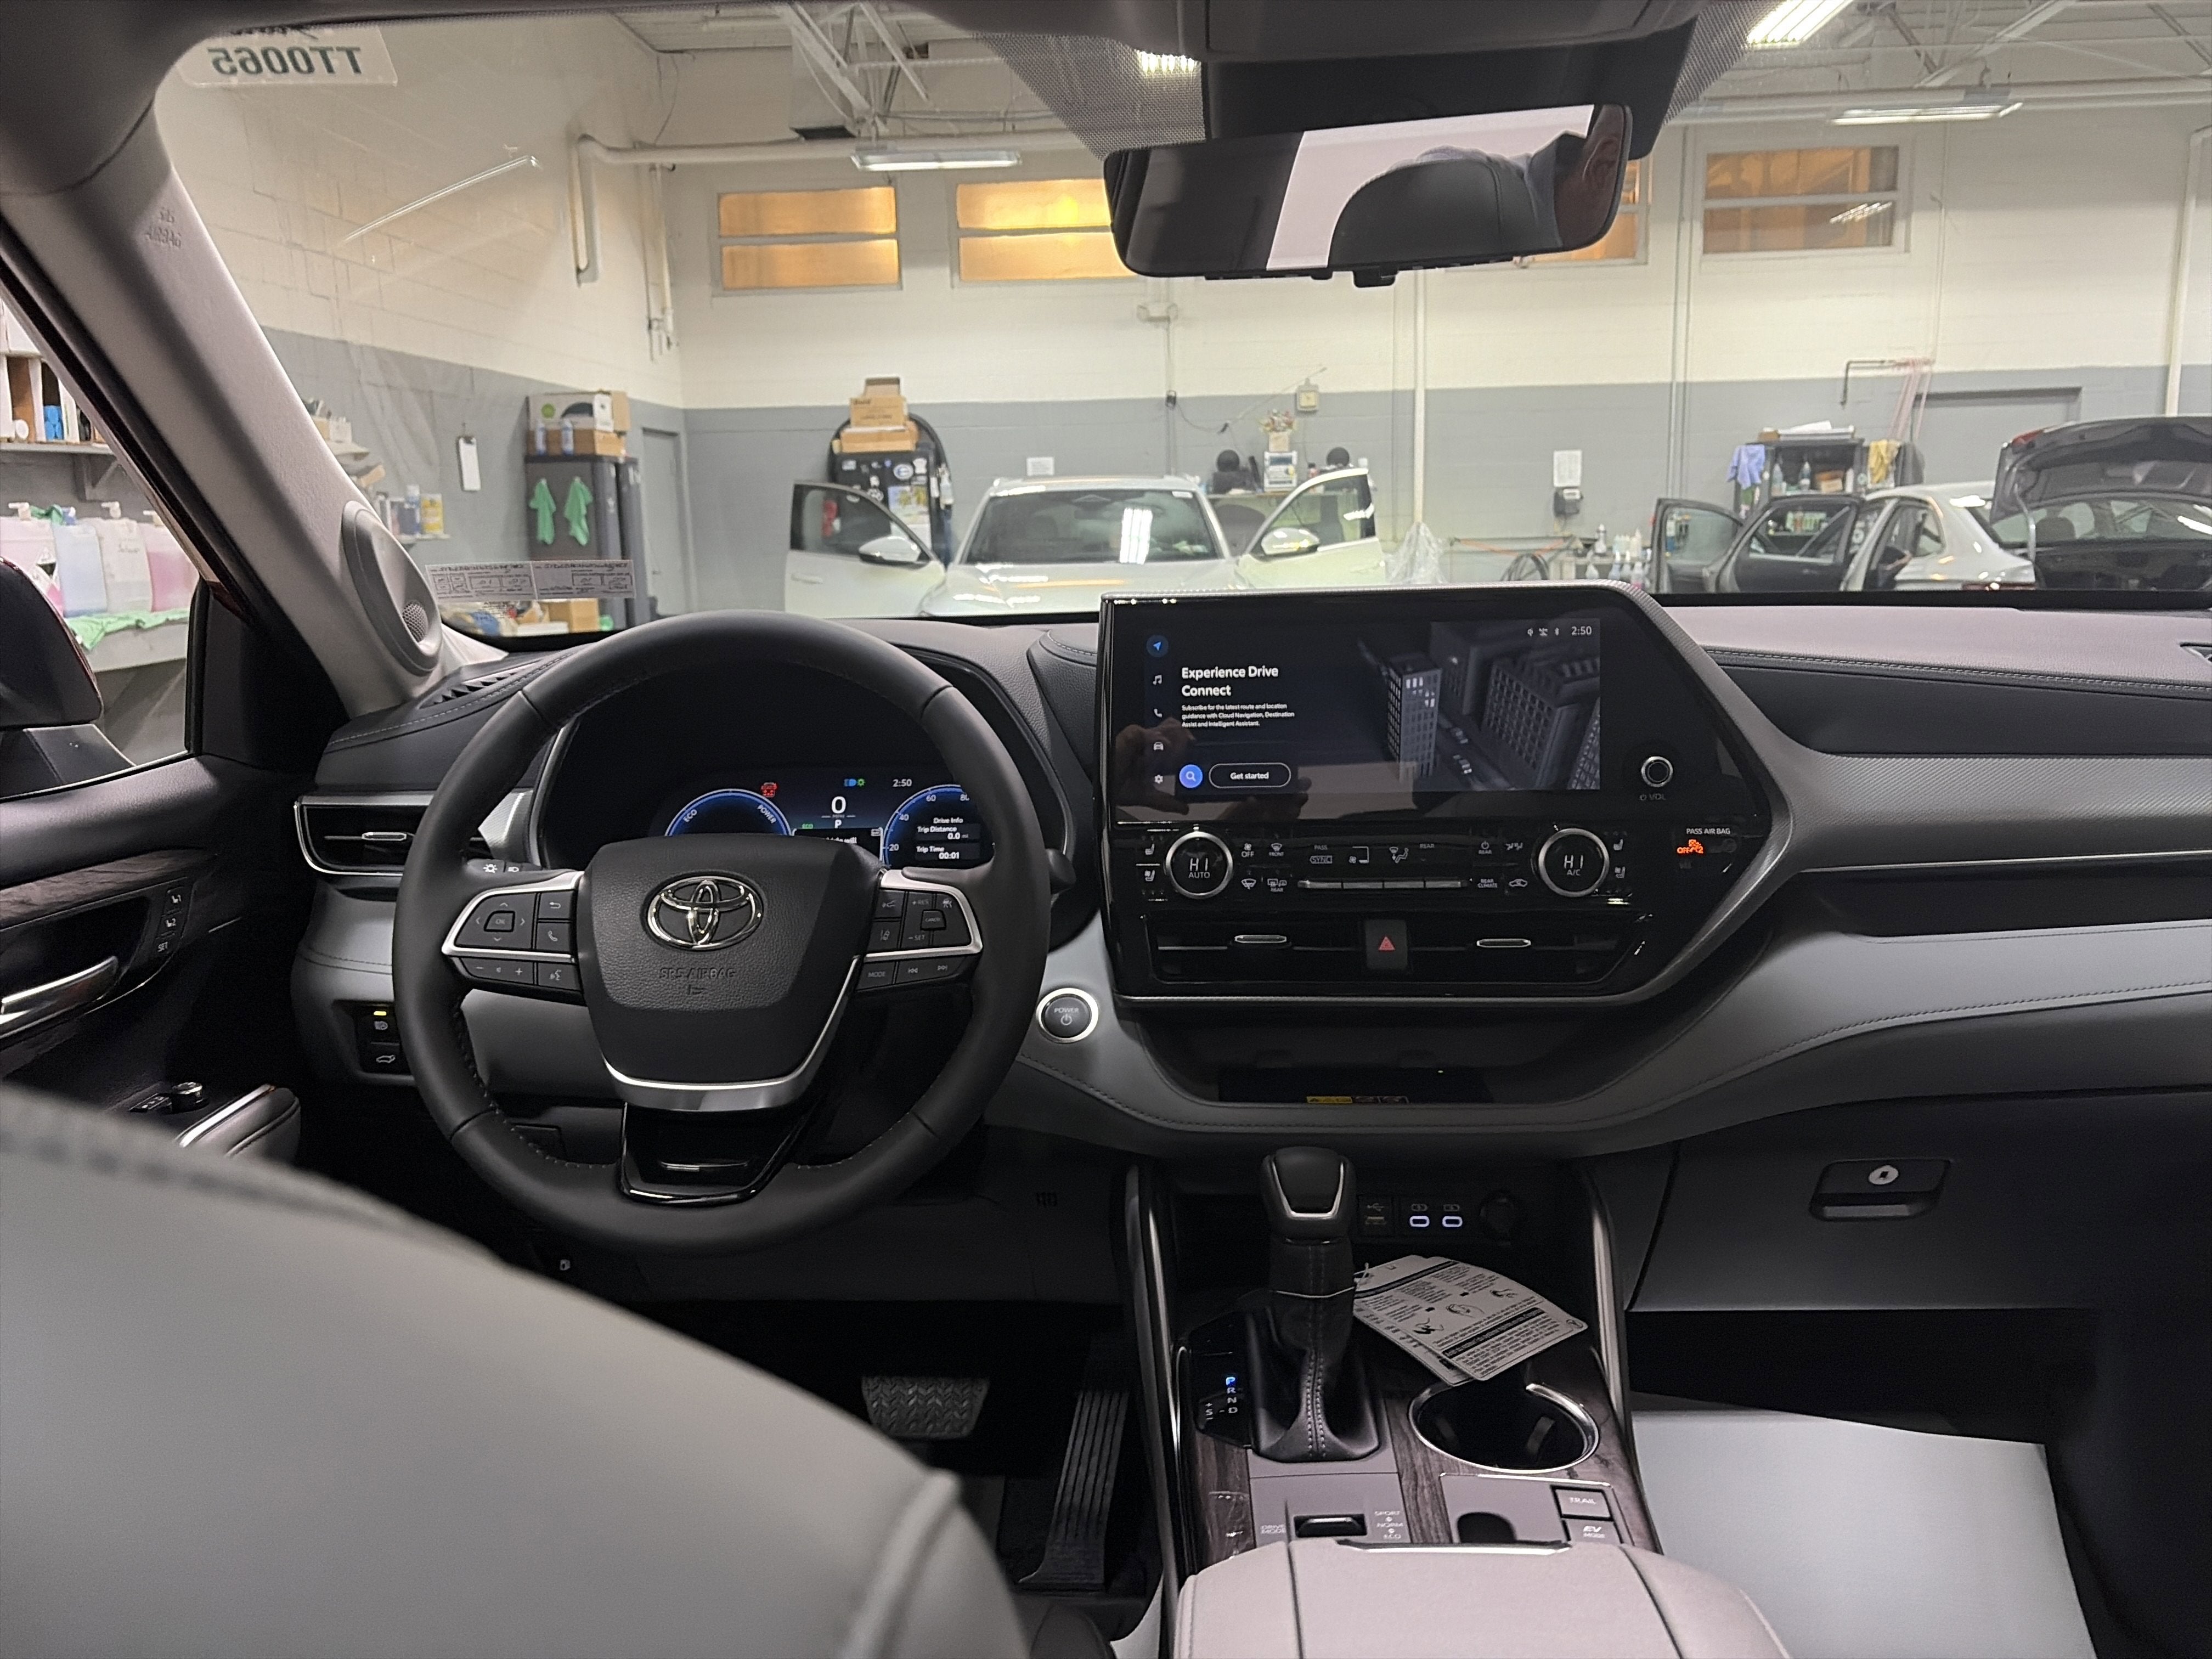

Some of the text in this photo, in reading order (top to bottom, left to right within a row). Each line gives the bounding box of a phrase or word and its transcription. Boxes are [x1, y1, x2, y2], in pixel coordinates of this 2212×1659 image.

[1571, 625, 1592, 636] 2:50
[1182, 665, 1279, 681] Experience Drive
[1181, 685, 1232, 697] Connect
[1244, 771, 1269, 780] started
[893, 778, 912, 787] 2:50
[831, 796, 846, 814] 0
[683, 809, 697, 823] ECO
[757, 804, 777, 824] POWER
[834, 819, 842, 829] P
[659, 968, 686, 979] SRS
[1226, 1376, 1236, 1385] P
